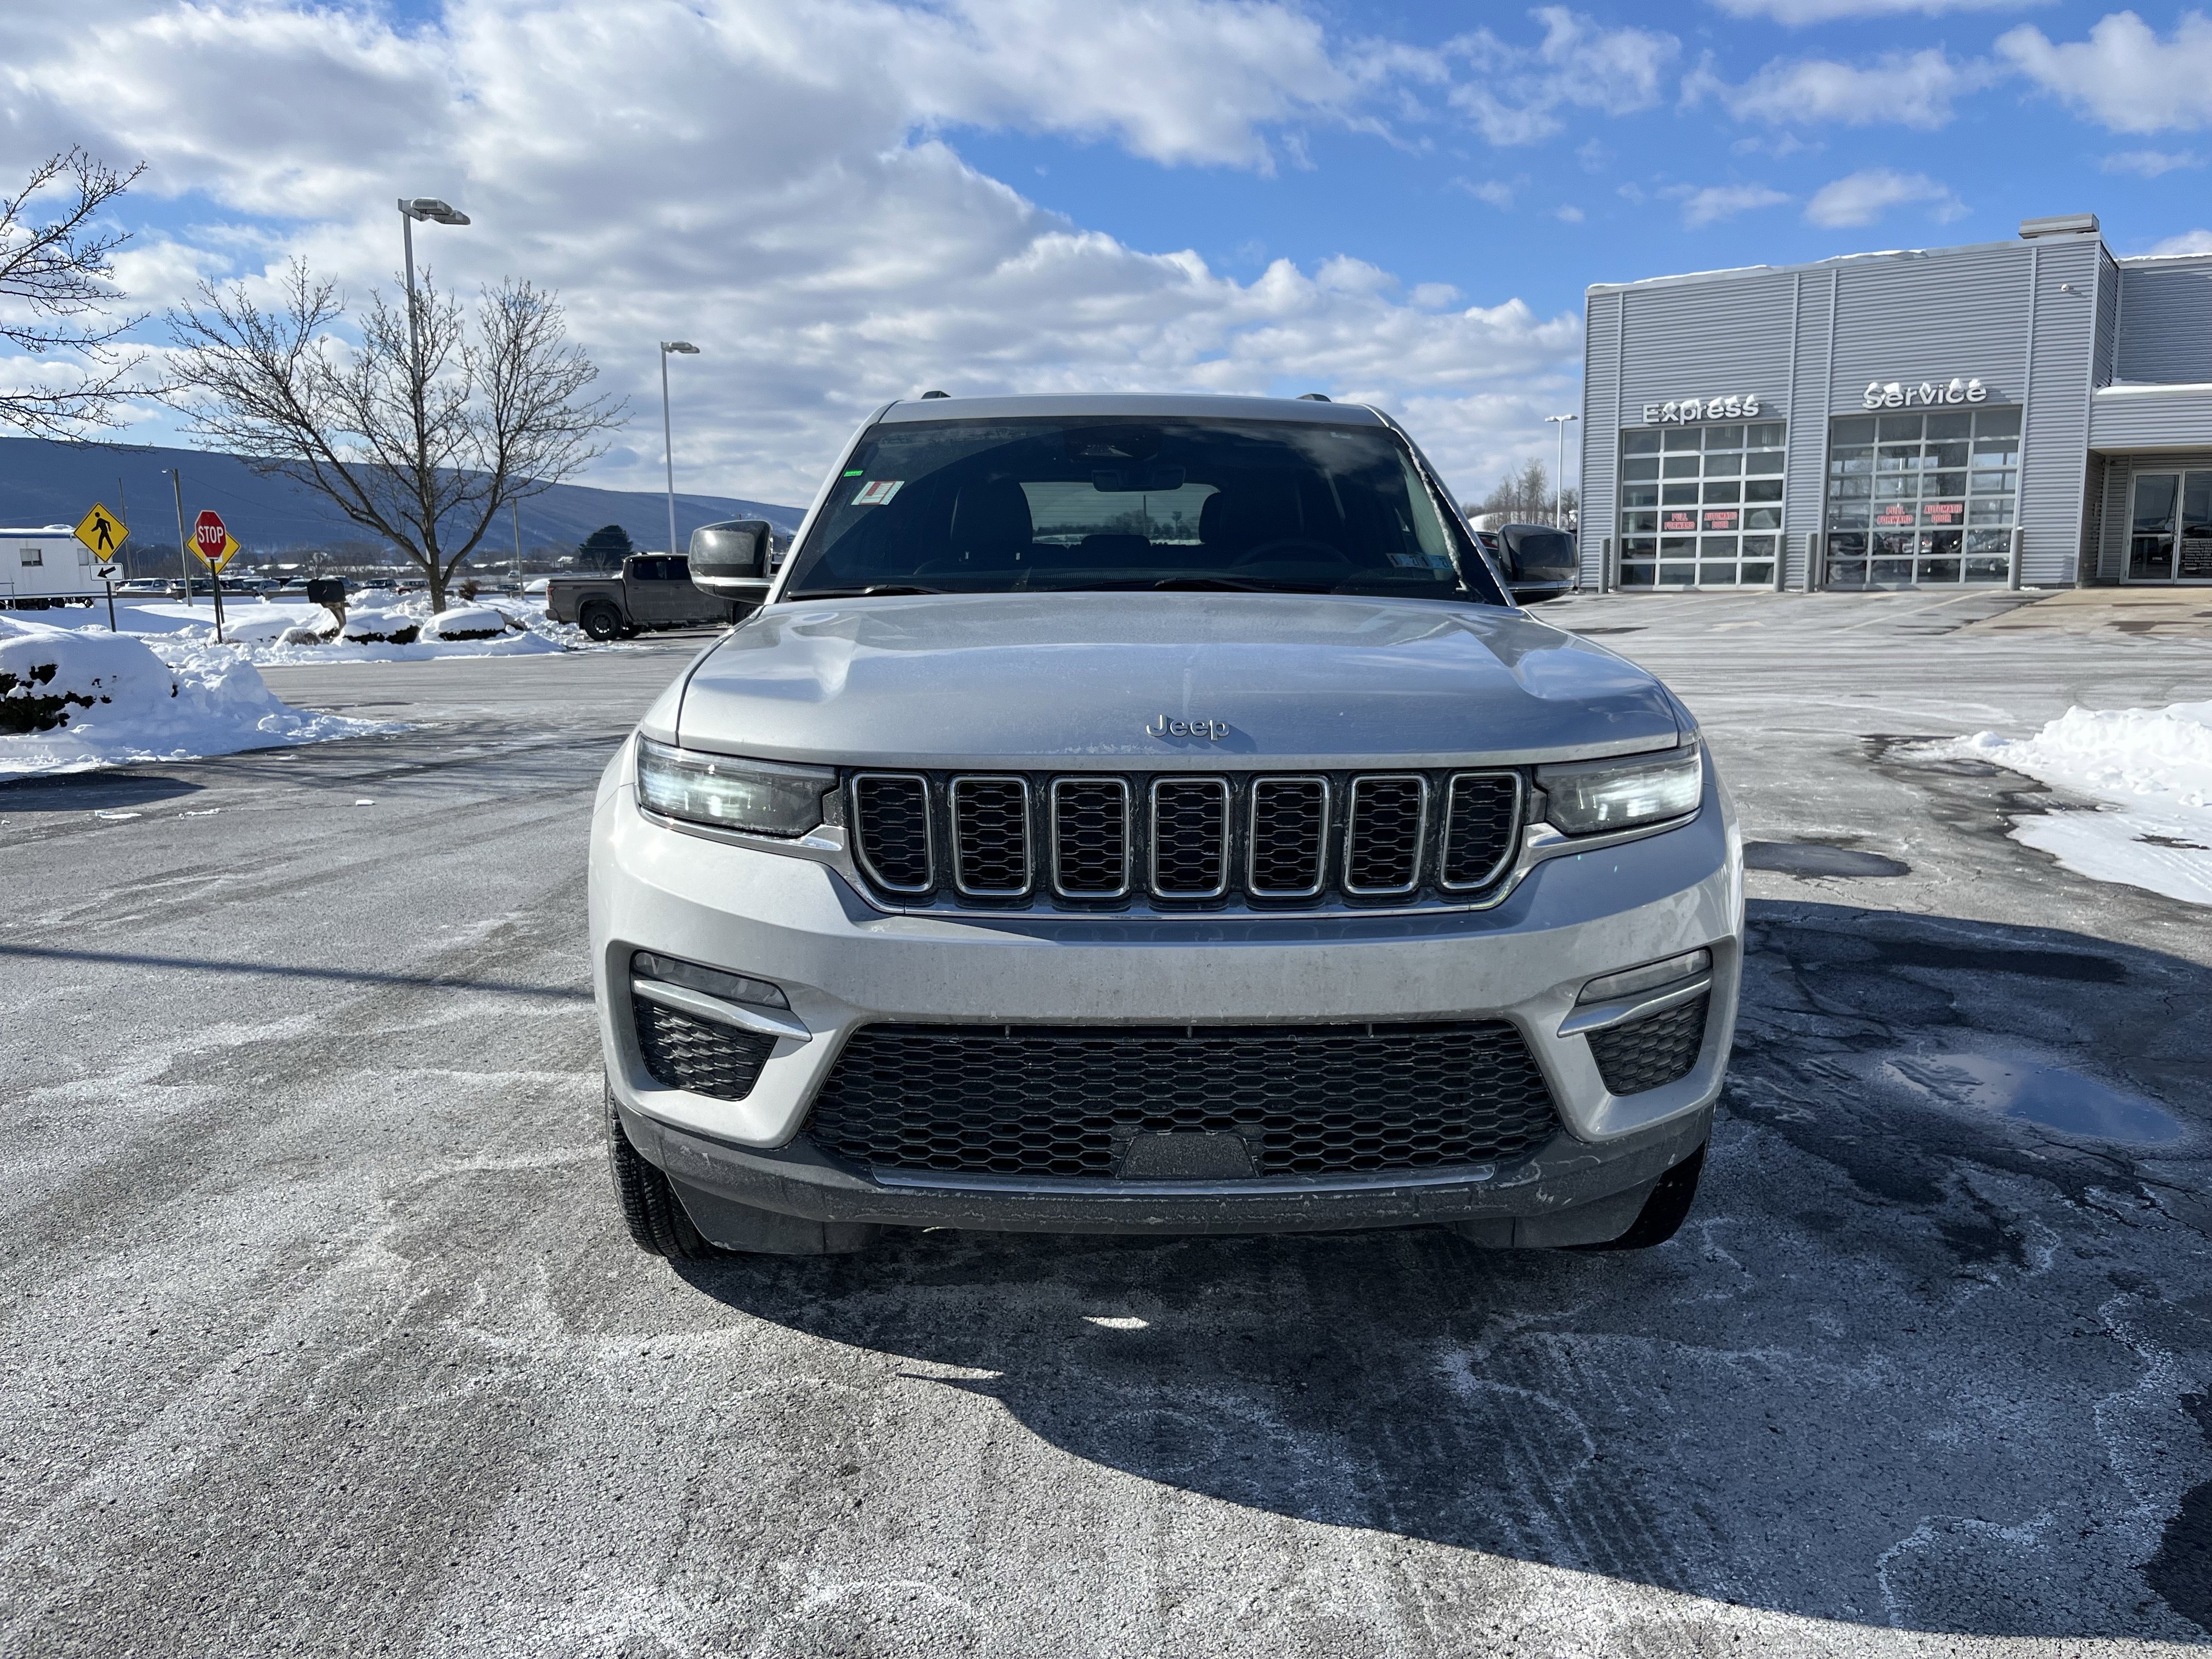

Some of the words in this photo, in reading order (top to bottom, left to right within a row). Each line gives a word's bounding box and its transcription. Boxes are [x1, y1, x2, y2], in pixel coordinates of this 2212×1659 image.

[1861, 381, 1987, 409] Service
[1643, 397, 1759, 426] Express
[198, 526, 224, 544] STOP
[1146, 714, 1230, 741] Jeep
